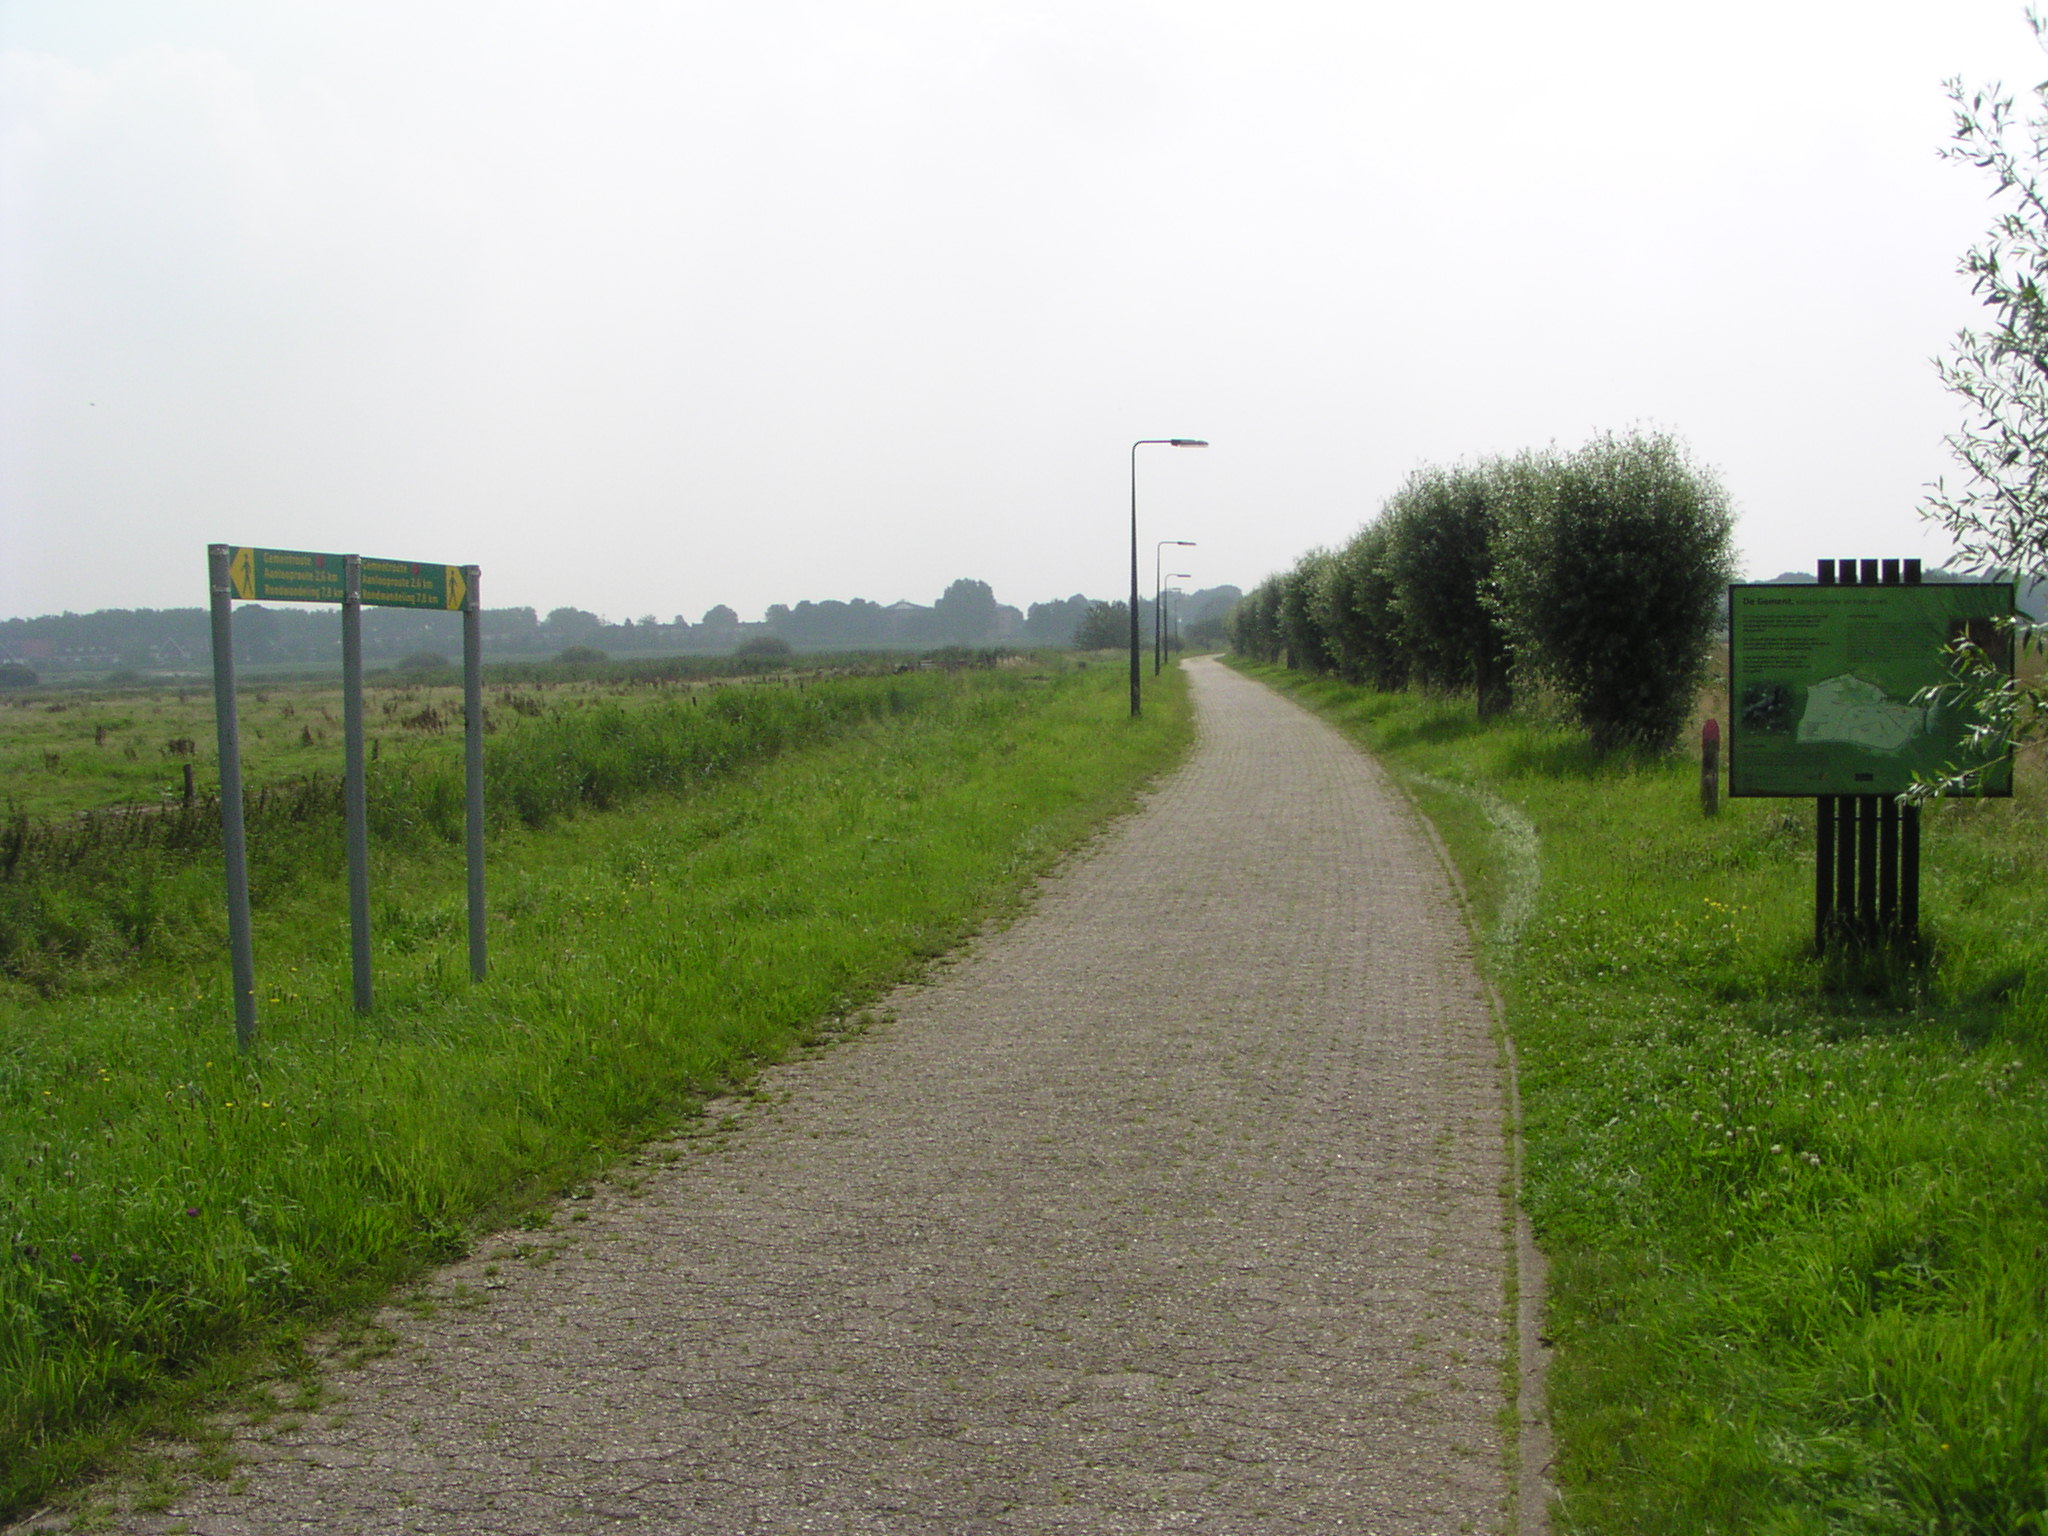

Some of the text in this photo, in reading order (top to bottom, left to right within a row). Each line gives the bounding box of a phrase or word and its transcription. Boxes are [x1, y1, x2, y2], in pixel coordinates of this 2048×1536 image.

[327, 572, 338, 582] km
[423, 578, 433, 590] km
[333, 587, 344, 598] km
[428, 593, 439, 604] km
[1743, 597, 1755, 606] De
